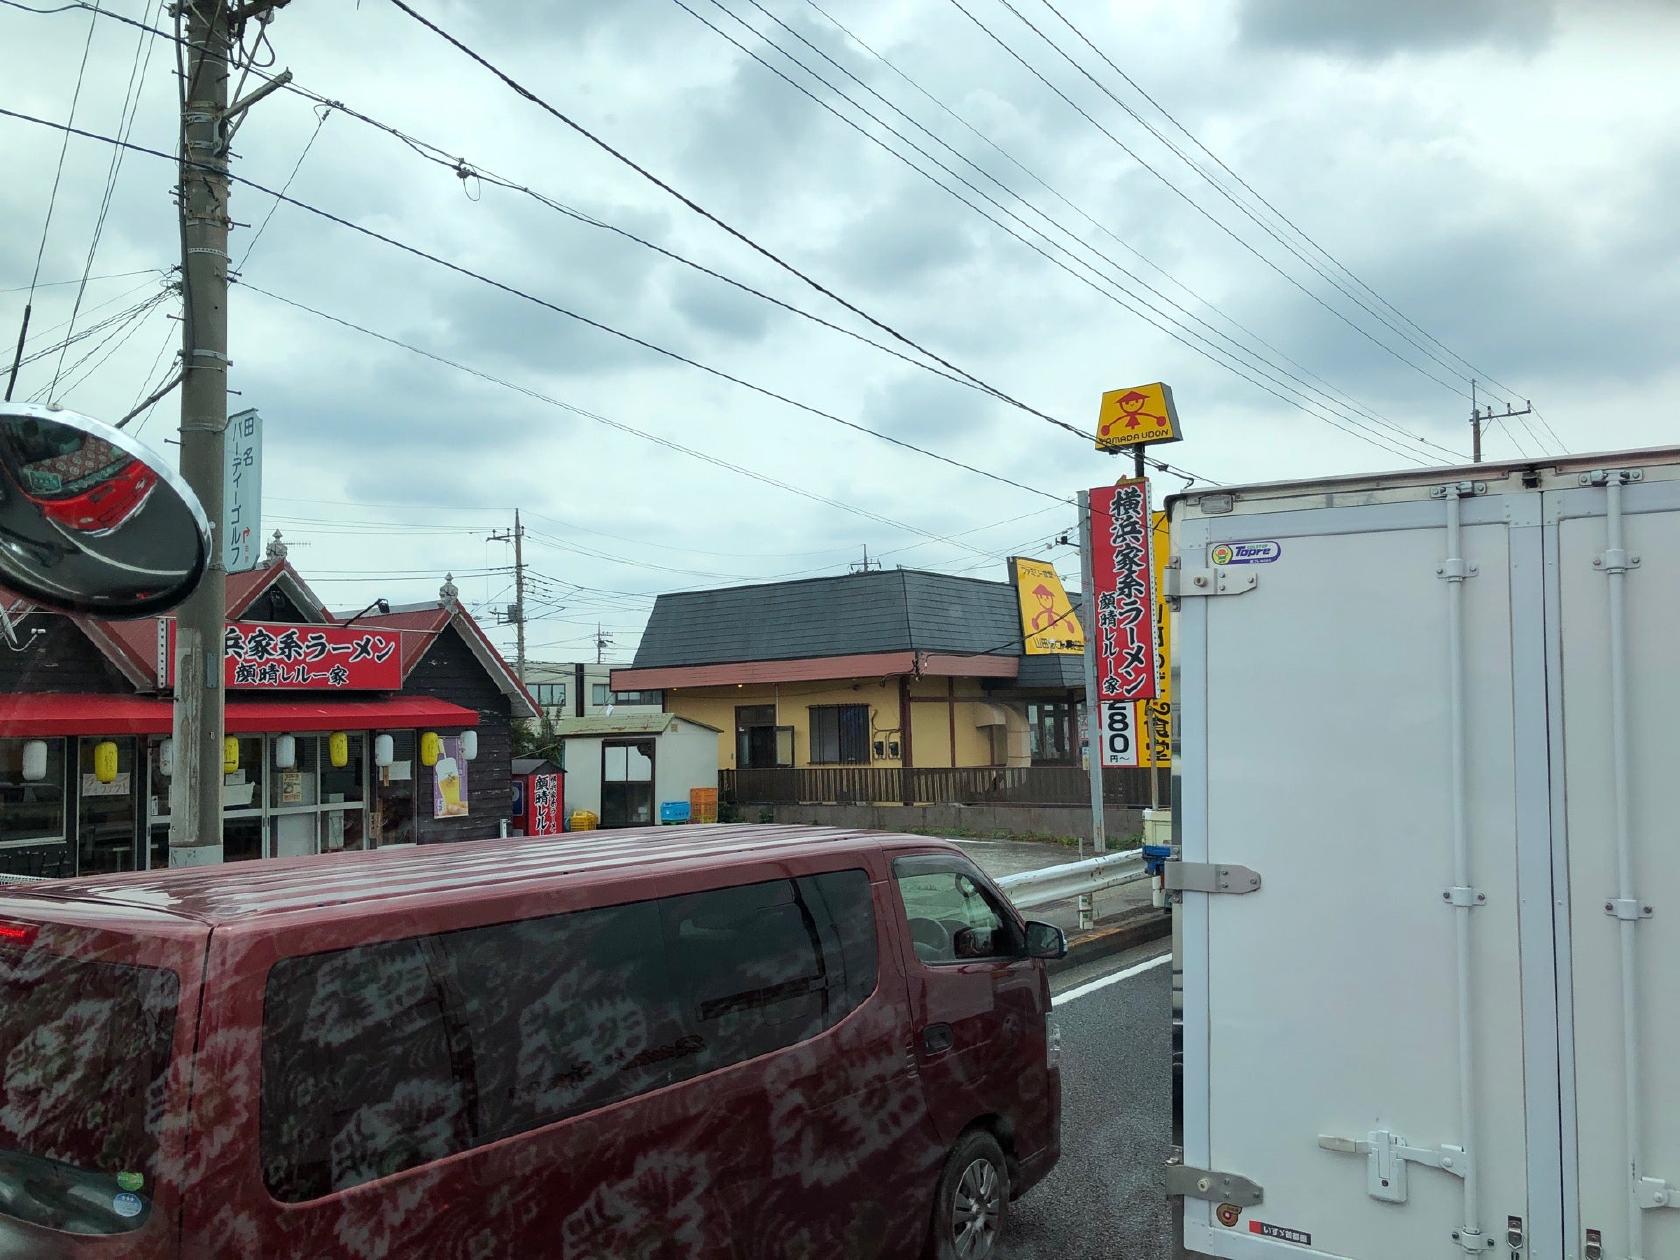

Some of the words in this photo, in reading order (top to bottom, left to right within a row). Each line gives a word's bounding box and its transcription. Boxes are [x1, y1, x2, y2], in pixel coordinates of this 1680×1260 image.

[243, 416, 254, 467] 田名
[1141, 428, 1169, 439] UDON
[1235, 544, 1271, 558] Topre
[1110, 486, 1146, 696] 横浜家系ラーメン
[224, 627, 395, 662] 浜家系ラーメン
